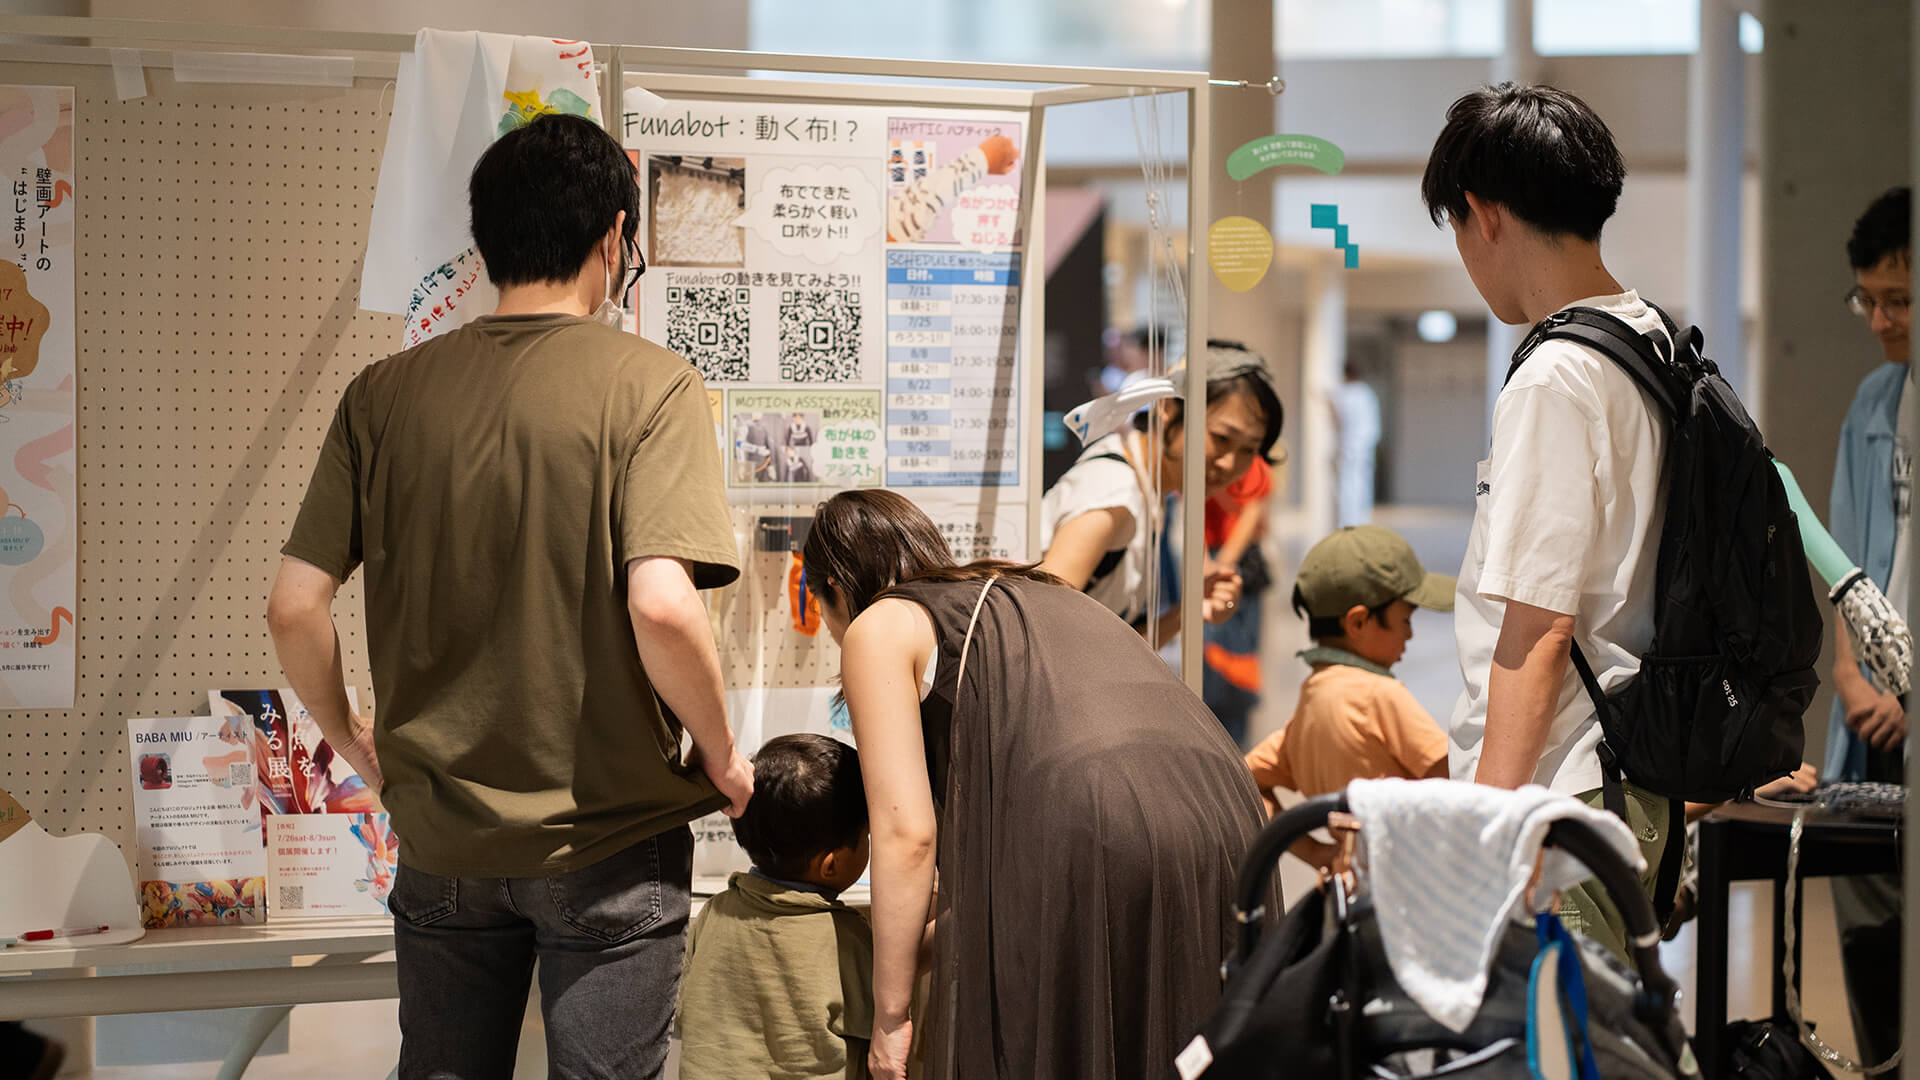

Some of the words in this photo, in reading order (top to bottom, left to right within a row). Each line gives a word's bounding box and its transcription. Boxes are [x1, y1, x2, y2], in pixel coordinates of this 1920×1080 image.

[780, 184, 851, 200] 布でできた
[37, 168, 52, 271] 壁画アートの
[773, 204, 859, 220] 柔らかく軽い
[781, 223, 849, 239] ロボット!!
[971, 231, 1009, 246] ねじる
[666, 271, 862, 291] Funabotの動きを見てみよう!!
[736, 396, 792, 409] MOTION
[795, 397, 875, 410] ASSISTANCE
[823, 408, 881, 419] 動作アシスト
[825, 428, 877, 442] 布が体の
[832, 445, 870, 460] 動きを
[824, 463, 878, 478] アシスト
[1722, 679, 1733, 696] cot
[1727, 694, 1738, 707] 25
[135, 732, 168, 744] BABA
[170, 730, 193, 742] MIU
[260, 703, 292, 779] みる展
